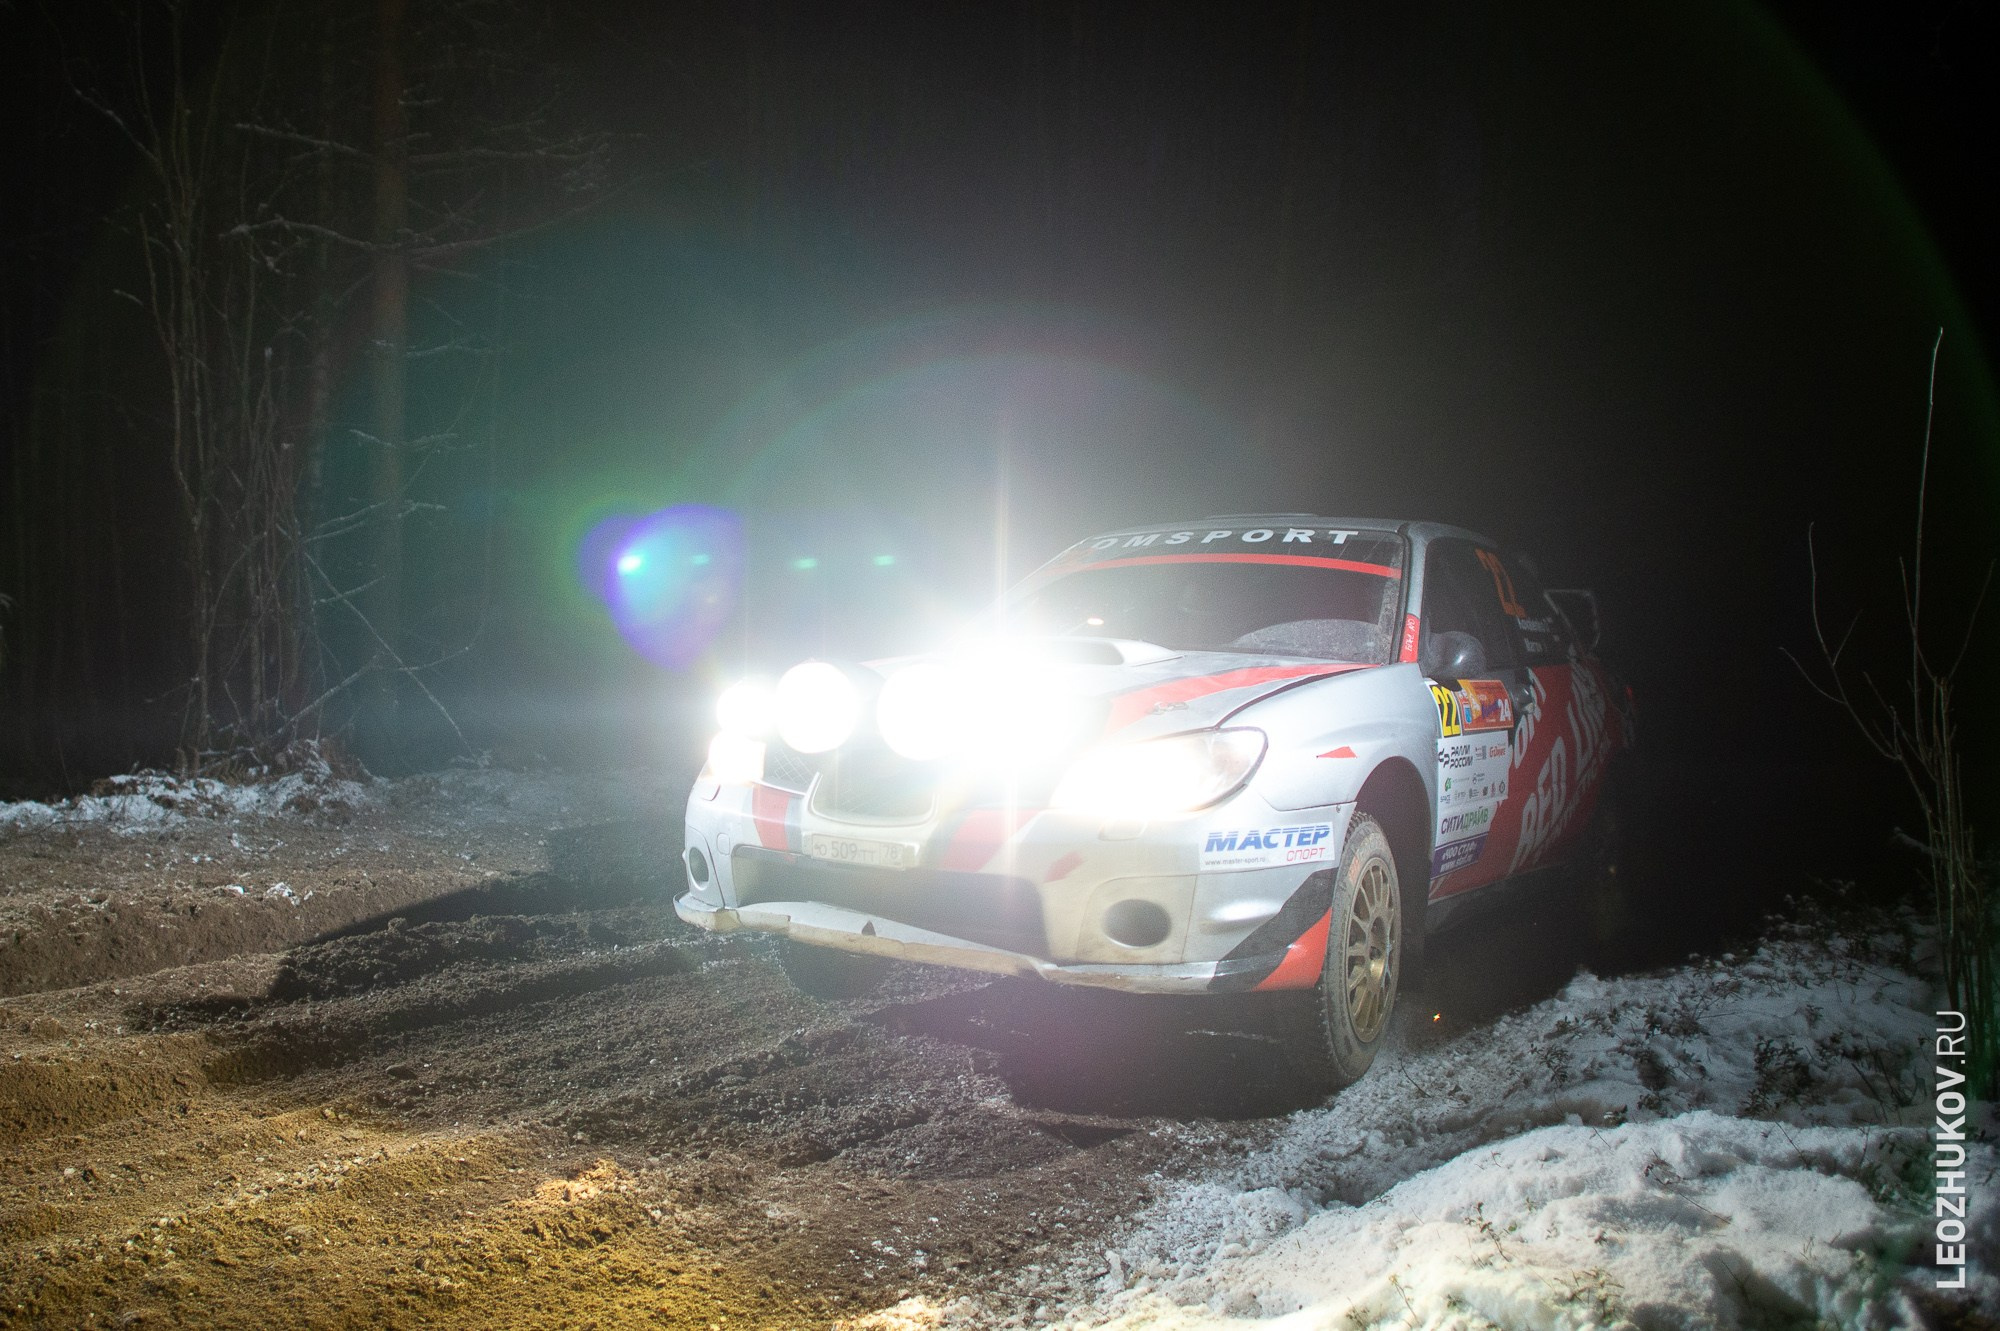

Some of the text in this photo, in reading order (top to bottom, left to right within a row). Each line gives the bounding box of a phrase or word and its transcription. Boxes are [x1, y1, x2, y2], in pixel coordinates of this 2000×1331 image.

[1431, 685, 1461, 736] 22
[1451, 744, 1470, 757] РАЛЛИ
[1450, 756, 1473, 769] РОССИИ
[1441, 806, 1489, 835] СИТИДРАЙВ
[1205, 825, 1330, 852] МАСТЕР
[1205, 857, 1266, 865] www.master-sport.ru
[1286, 848, 1325, 861] СПОРТ
